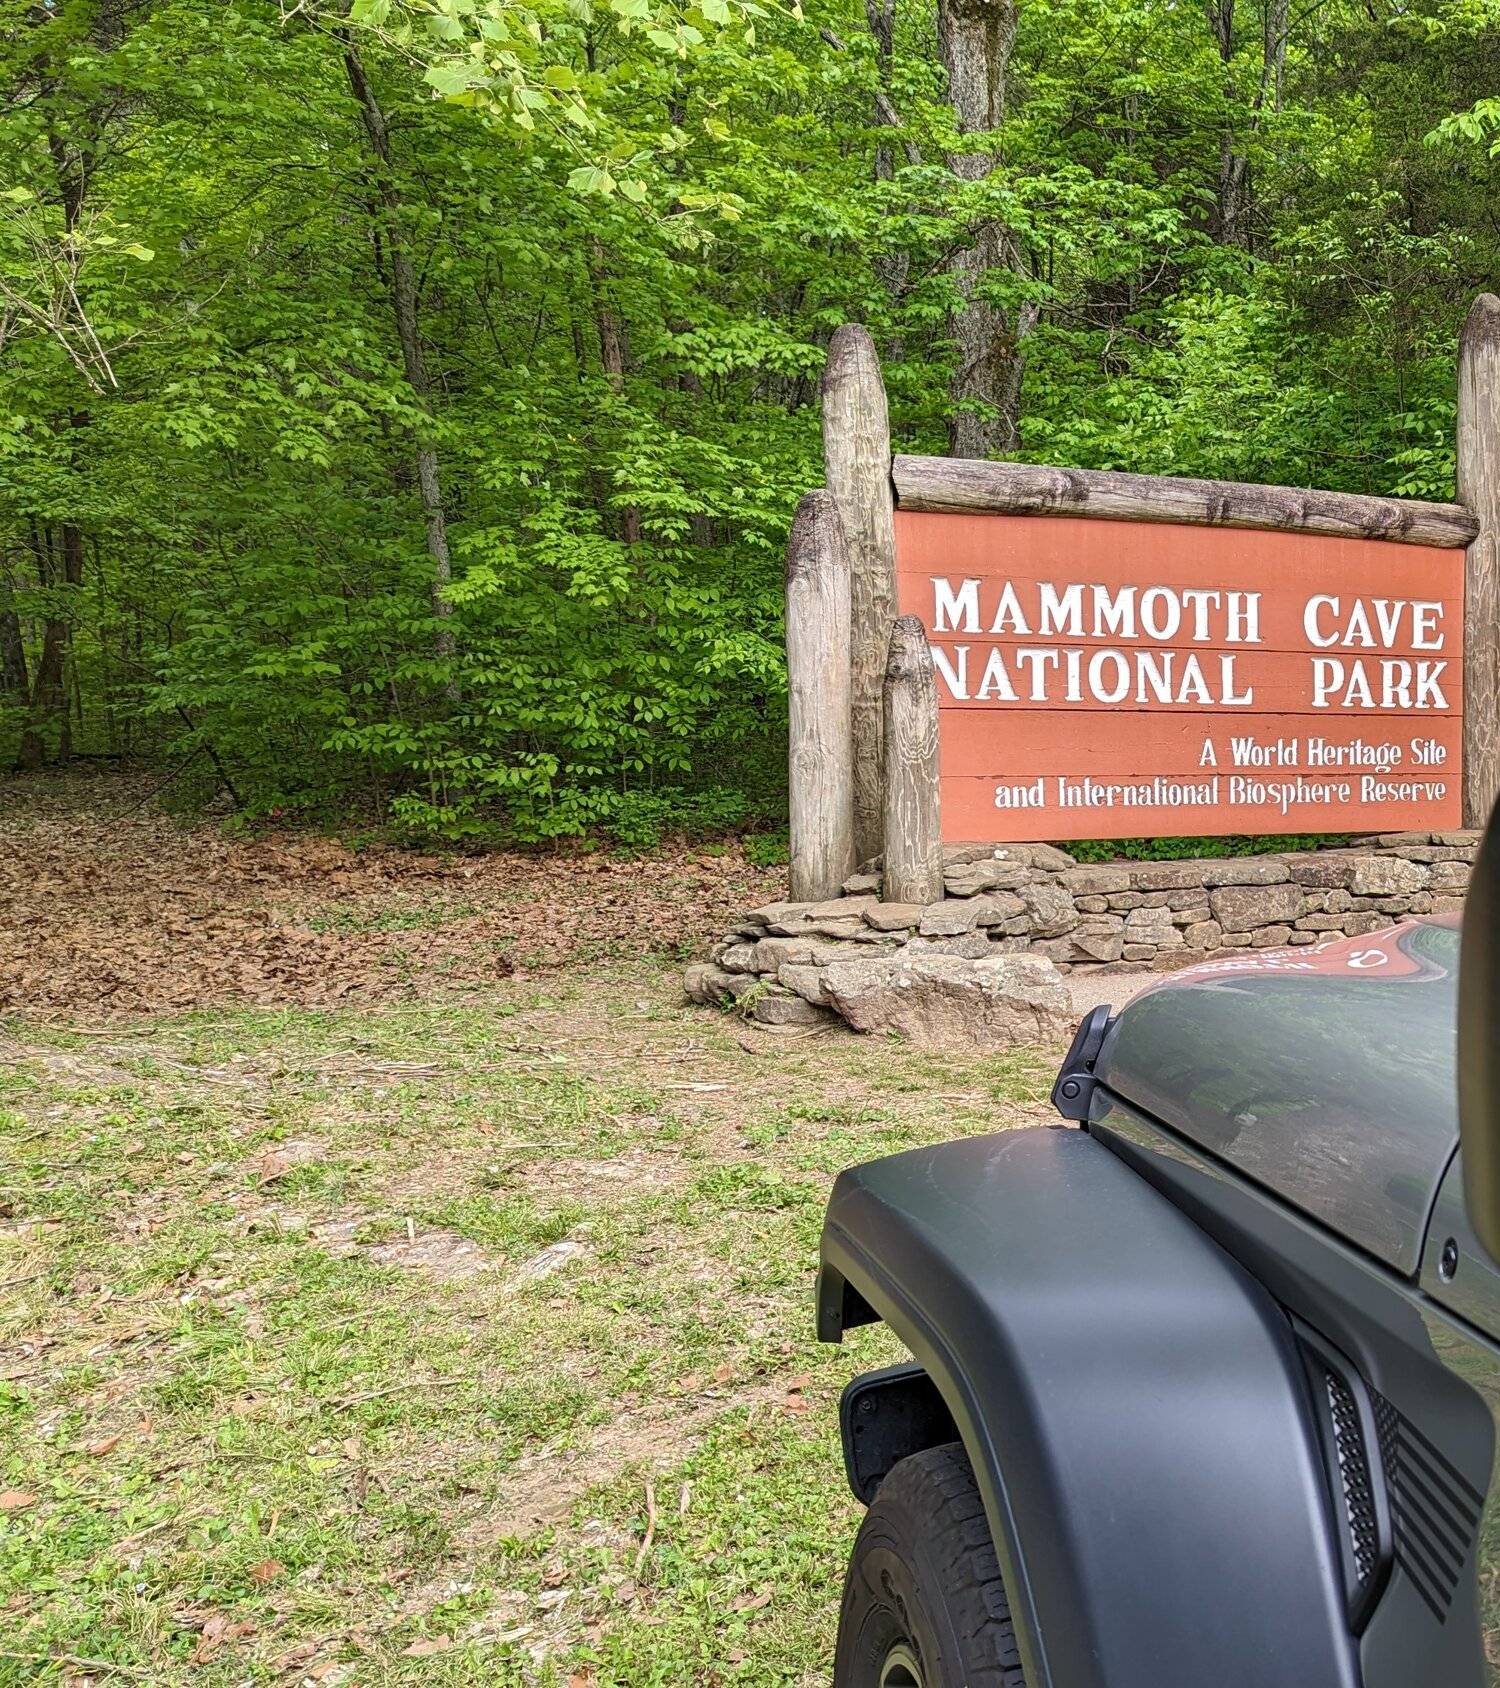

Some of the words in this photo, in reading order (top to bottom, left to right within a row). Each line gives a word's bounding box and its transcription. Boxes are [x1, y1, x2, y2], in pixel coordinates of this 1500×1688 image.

[929, 577, 1262, 643] MAMMOTH
[1303, 594, 1445, 650] CAVE
[929, 645, 1253, 708] NATIONAL
[1310, 657, 1450, 709] PARK
[1199, 738, 1218, 767] A
[1230, 736, 1298, 767] World
[1307, 737, 1402, 774] Heritage
[1410, 737, 1447, 765] Site
[994, 777, 1046, 809] and
[1057, 775, 1219, 807] International
[1229, 775, 1351, 816] Biosphere
[1360, 775, 1446, 803] Reserve
